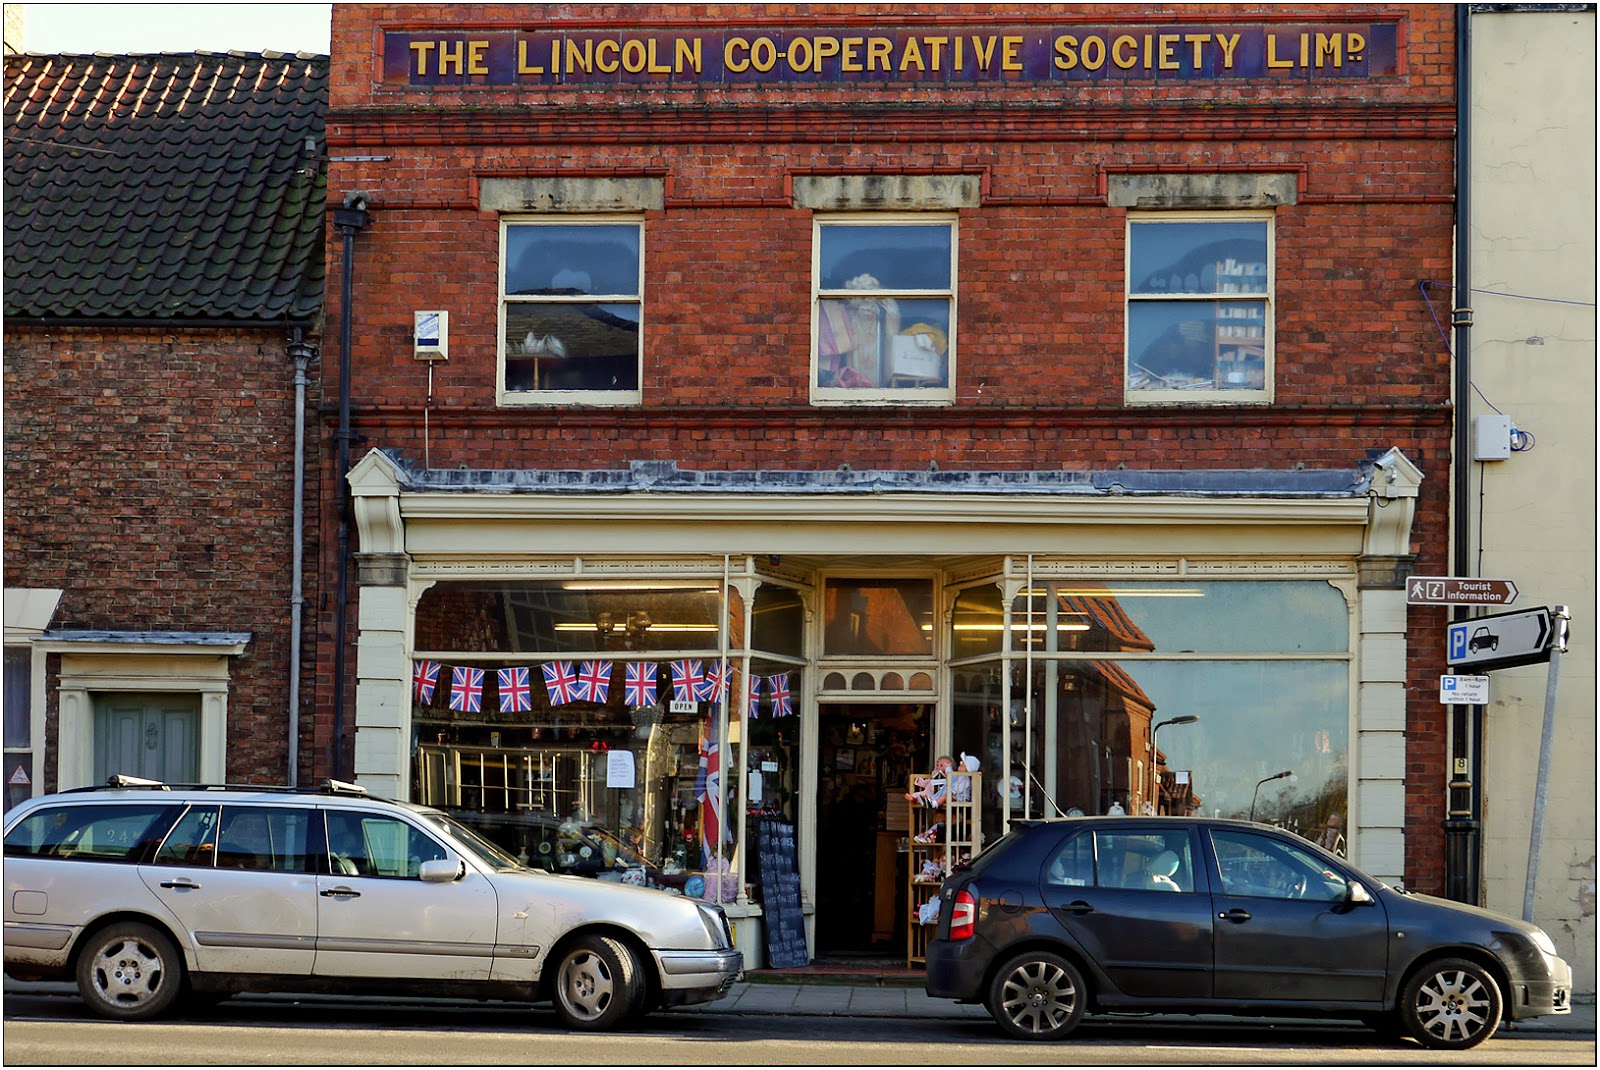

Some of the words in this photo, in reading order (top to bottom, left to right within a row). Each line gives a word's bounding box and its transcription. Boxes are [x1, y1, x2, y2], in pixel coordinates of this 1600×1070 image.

[409, 39, 489, 76] THE
[517, 37, 702, 75] LINCOLN
[724, 35, 1025, 73] CO-OPERATIVE
[1053, 33, 1242, 71] SOCIETY
[1458, 581, 1492, 591] Tourist
[1447, 591, 1502, 601] information
[1453, 629, 1465, 657] P
[1444, 678, 1455, 690] P
[674, 703, 693, 711] OPEN
